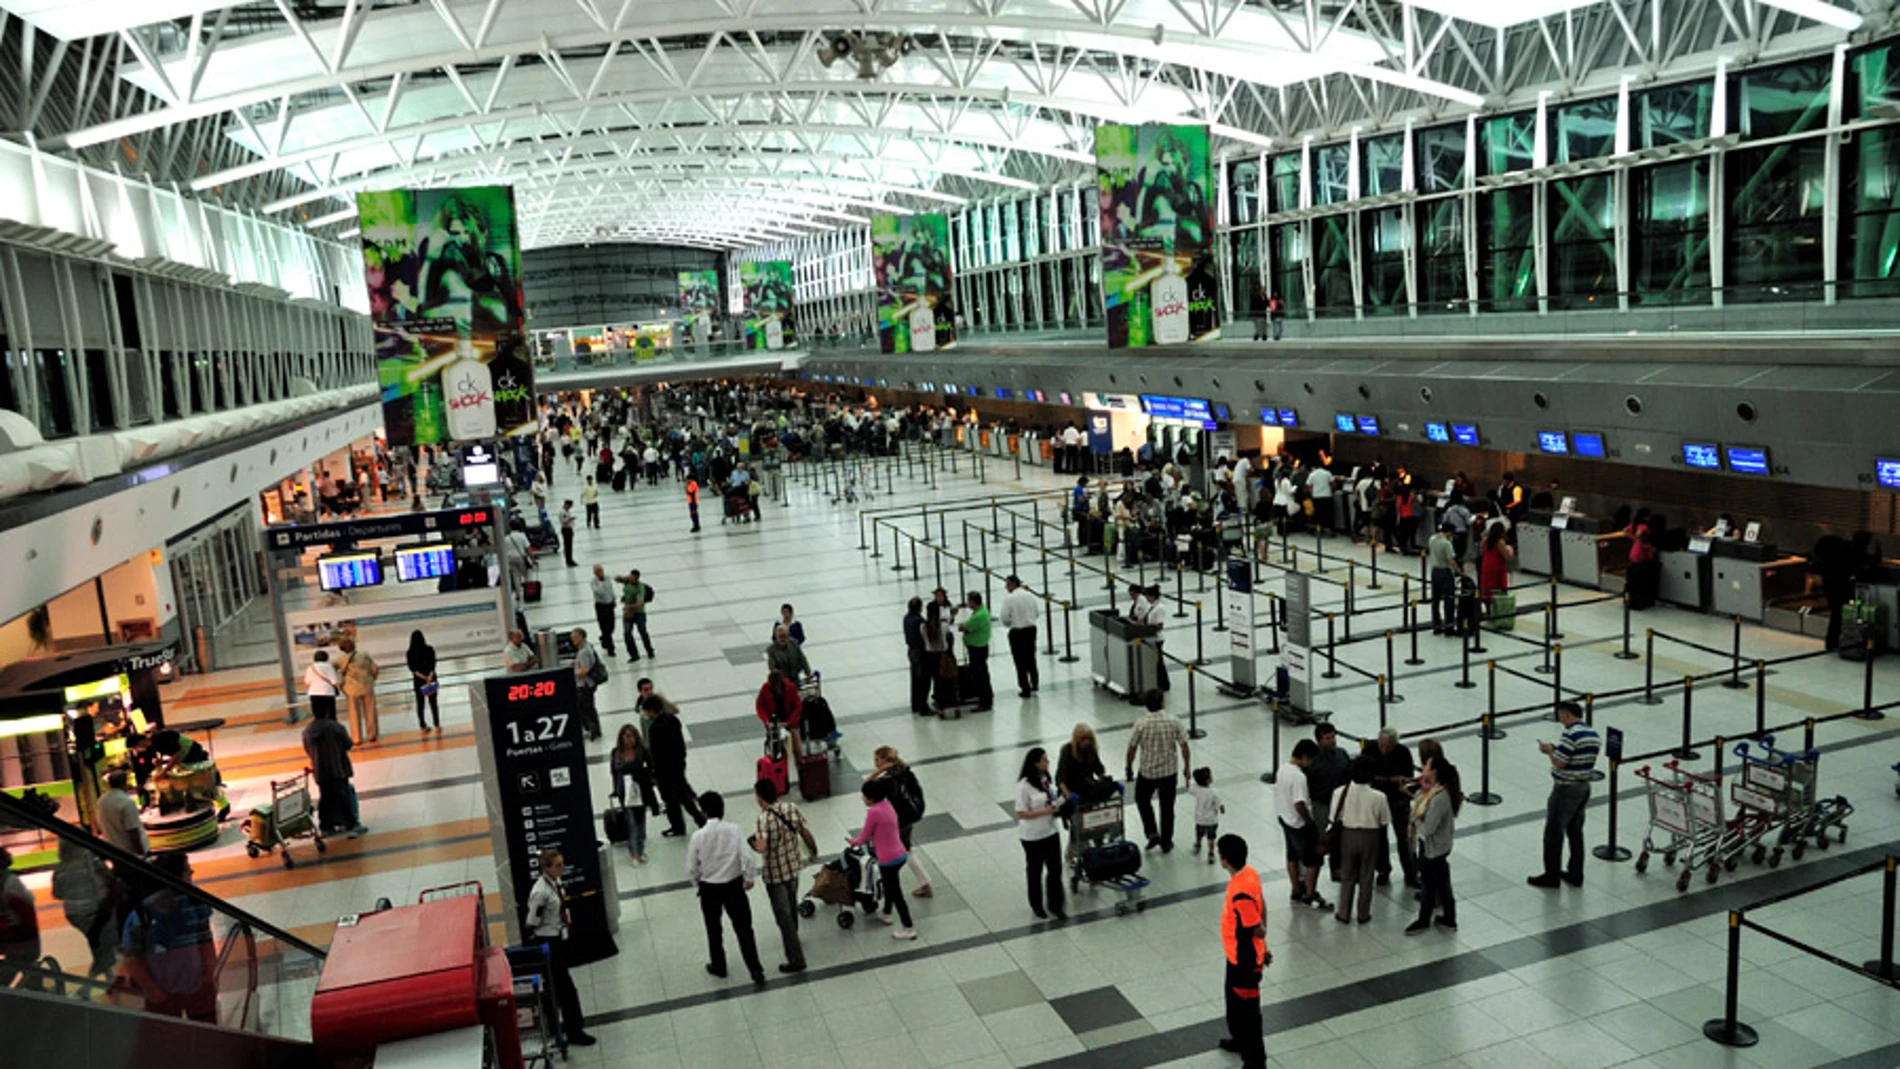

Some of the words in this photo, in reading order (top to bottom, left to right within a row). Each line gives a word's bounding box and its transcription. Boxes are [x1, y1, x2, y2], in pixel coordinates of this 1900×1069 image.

[294, 528, 341, 542] Partidas
[348, 522, 402, 536] Departures
[508, 680, 556, 702] 20:20
[506, 720, 520, 745] 1
[523, 729, 536, 743] a
[536, 713, 569, 741] 27
